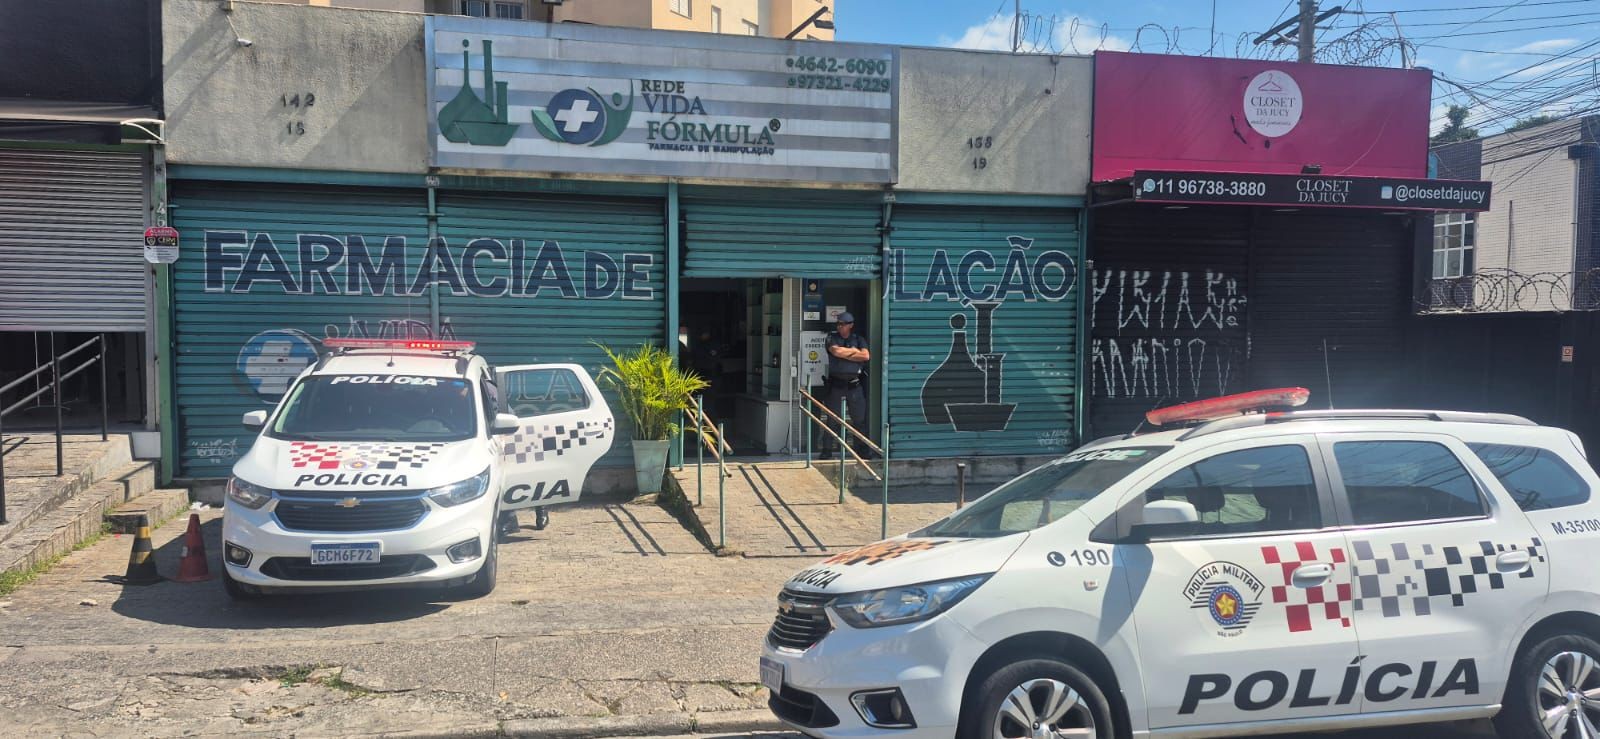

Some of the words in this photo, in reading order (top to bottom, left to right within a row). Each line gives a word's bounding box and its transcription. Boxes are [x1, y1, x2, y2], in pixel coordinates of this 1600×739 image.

[795, 56, 887, 75] 4642-6090
[640, 79, 686, 93] REDE
[797, 74, 891, 93] 97321-4229
[642, 93, 708, 116] VIDA
[1250, 96, 1296, 108] CLOSET
[646, 115, 776, 146] FÓRMULA
[1156, 178, 1174, 194] 11
[1178, 179, 1267, 197] 96738-3880
[1296, 178, 1353, 193] CLOSET
[1395, 184, 1486, 204] @closetdajucy
[1299, 191, 1315, 202] DA
[1318, 192, 1349, 204] JUCY
[203, 229, 580, 299] FARMACIA
[583, 250, 655, 300] DE
[882, 235, 1077, 307] LAÇÃO
[294, 471, 408, 487] POLÍCIA
[503, 479, 570, 504] CIA
[1070, 549, 1110, 566] 190
[1187, 565, 1219, 598] POLÍCIA
[1222, 564, 1260, 593] MILITAR
[1177, 655, 1480, 715] POLÍCIA
